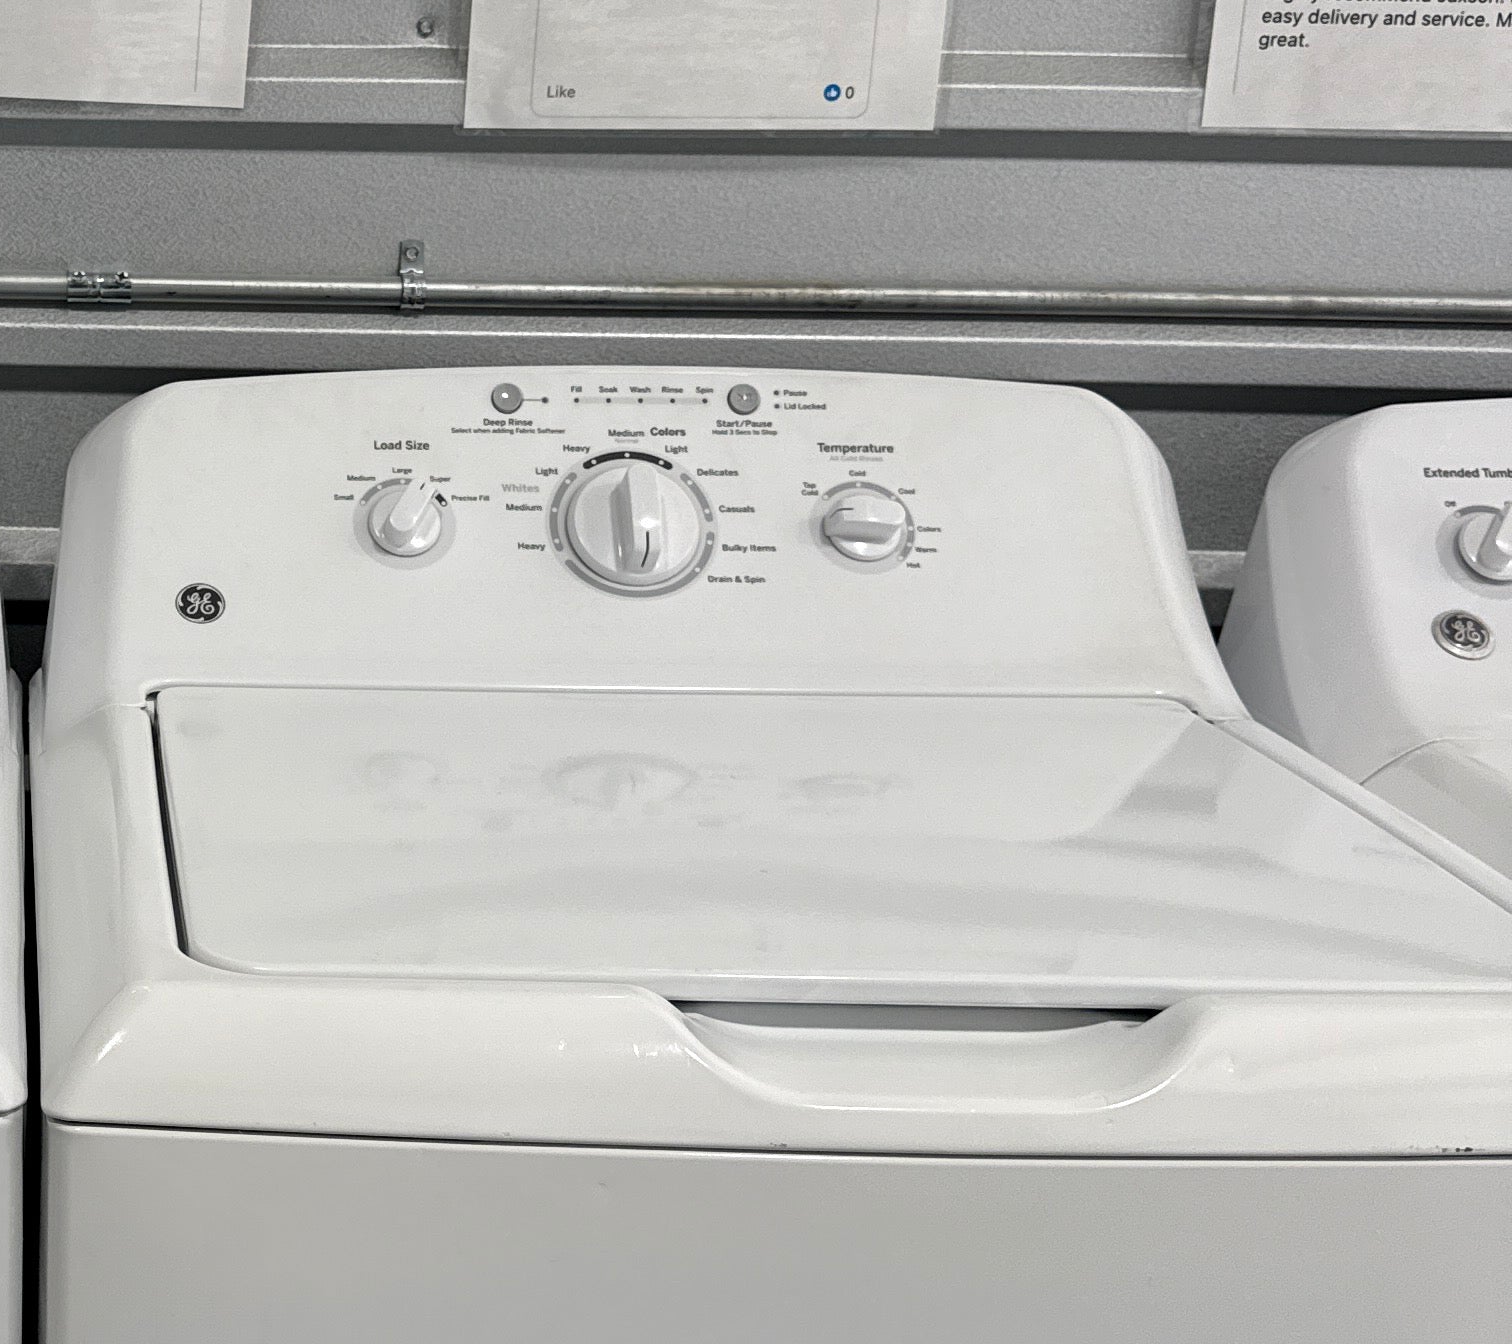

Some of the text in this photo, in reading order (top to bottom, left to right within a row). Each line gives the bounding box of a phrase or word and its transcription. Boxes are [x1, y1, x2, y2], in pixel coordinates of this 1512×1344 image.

[1258, 32, 1310, 51] great.
[546, 85, 855, 100] Like 0
[482, 417, 534, 428] Deep Rinse
[715, 419, 773, 428] Start/Pause
[649, 426, 687, 437] Colors
[373, 439, 430, 451] Load Size
[562, 444, 591, 455] Heavy
[664, 444, 689, 455] Light
[816, 442, 895, 456] Temperature
[535, 467, 559, 477] Light
[696, 468, 740, 477] Delicates
[1423, 467, 1481, 479] Extended
[718, 504, 756, 514] Casuals
[721, 543, 748, 554] Bulky
[743, 575, 767, 585] Spin
